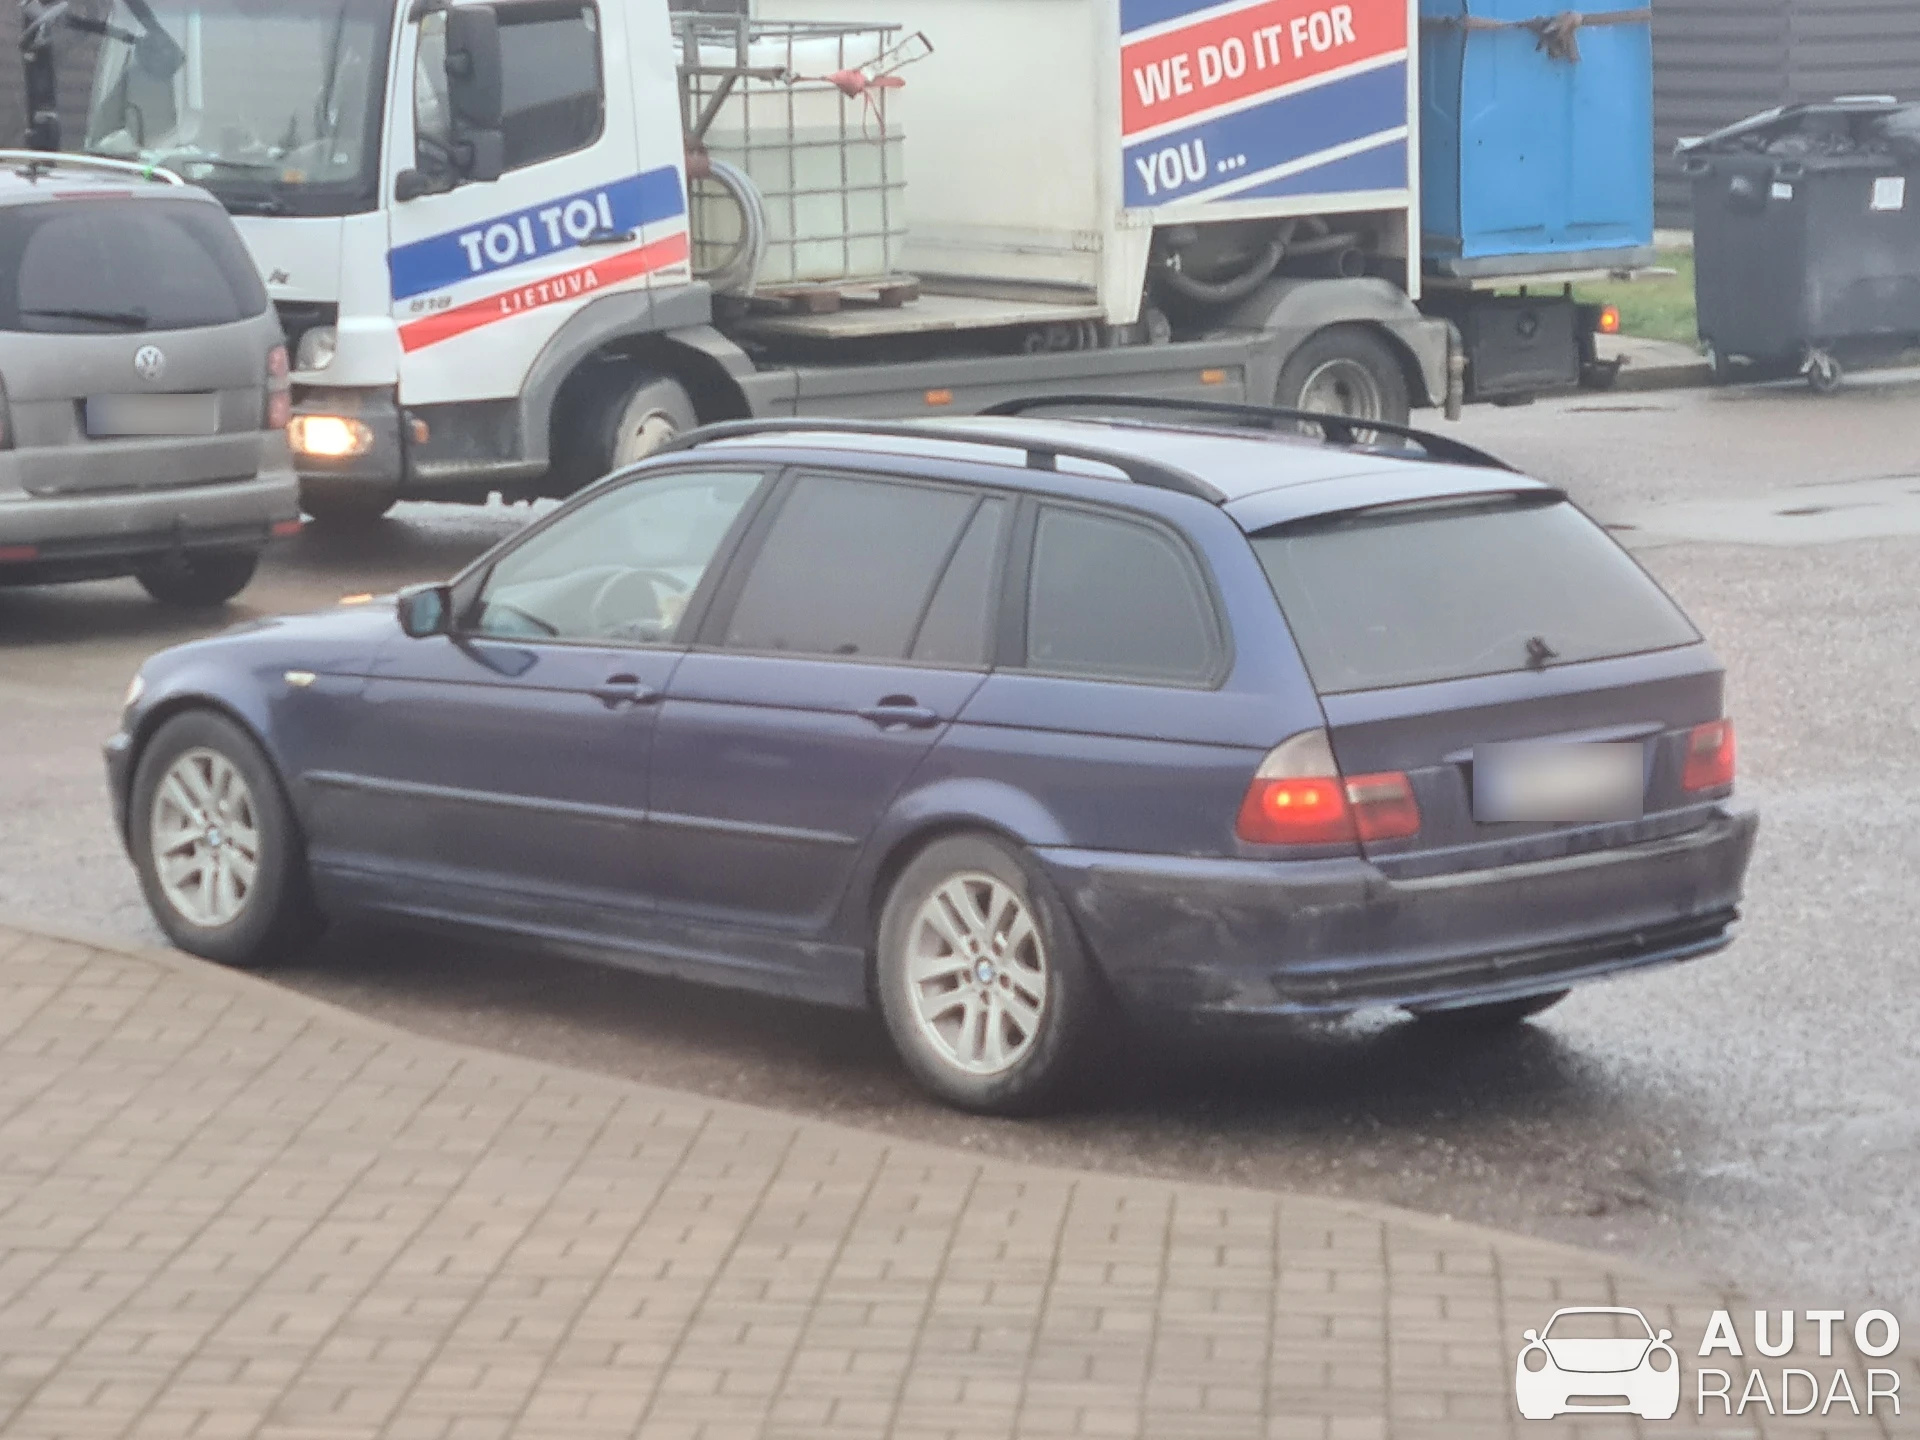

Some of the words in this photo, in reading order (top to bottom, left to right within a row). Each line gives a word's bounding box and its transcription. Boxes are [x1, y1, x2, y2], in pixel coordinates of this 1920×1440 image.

[1132, 53, 1194, 108] WE
[1196, 37, 1247, 88] DO
[1251, 24, 1283, 71] IT
[1289, 4, 1357, 59] FOR
[1134, 138, 1208, 197] YOU
[458, 216, 537, 272] TOI
[539, 192, 614, 247] TOI
[499, 267, 599, 315] LIETUVA
